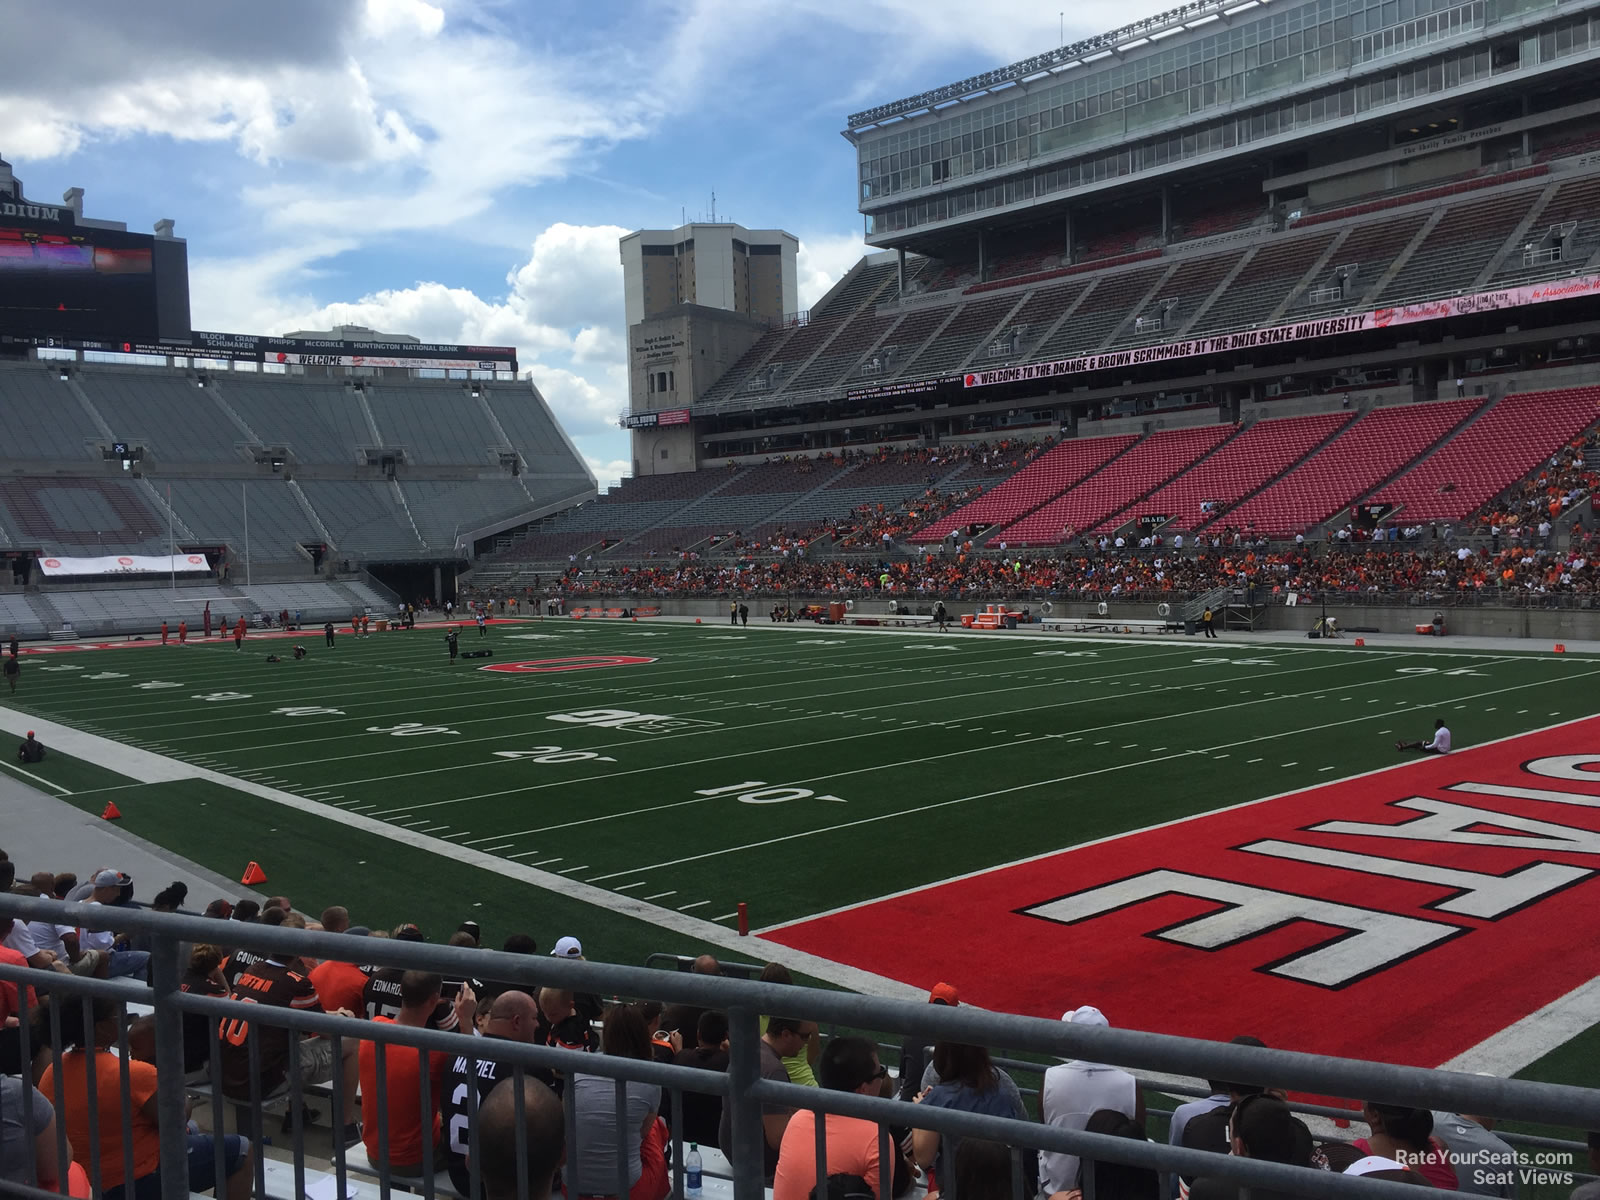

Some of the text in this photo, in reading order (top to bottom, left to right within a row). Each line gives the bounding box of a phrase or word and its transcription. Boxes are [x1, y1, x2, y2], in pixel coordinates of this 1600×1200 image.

[0, 203, 59, 222] DIUM
[1532, 290, 1540, 298] In
[1542, 283, 1590, 297] Association
[49, 338, 54, 346] 3
[200, 332, 225, 341] BLOCH
[234, 335, 259, 343] CRANE
[268, 338, 296, 346] PHIPPS
[305, 340, 344, 348] McCORKLE
[353, 342, 400, 350] HUNTINGTON
[403, 344, 437, 352] NATIONAL
[207, 339, 255, 349] SCHUMAKER
[980, 315, 1366, 385] WELCOME TO THE ORANGE & BROWN SCRIMMAGE AT THE OHIO STATE UNIVERSITY
[299, 354, 342, 365] WELCOME
[366, 722, 449, 737] 30
[492, 745, 599, 763] 20
[693, 781, 815, 804] 10
[453, 1055, 497, 1080] MAZIEL
